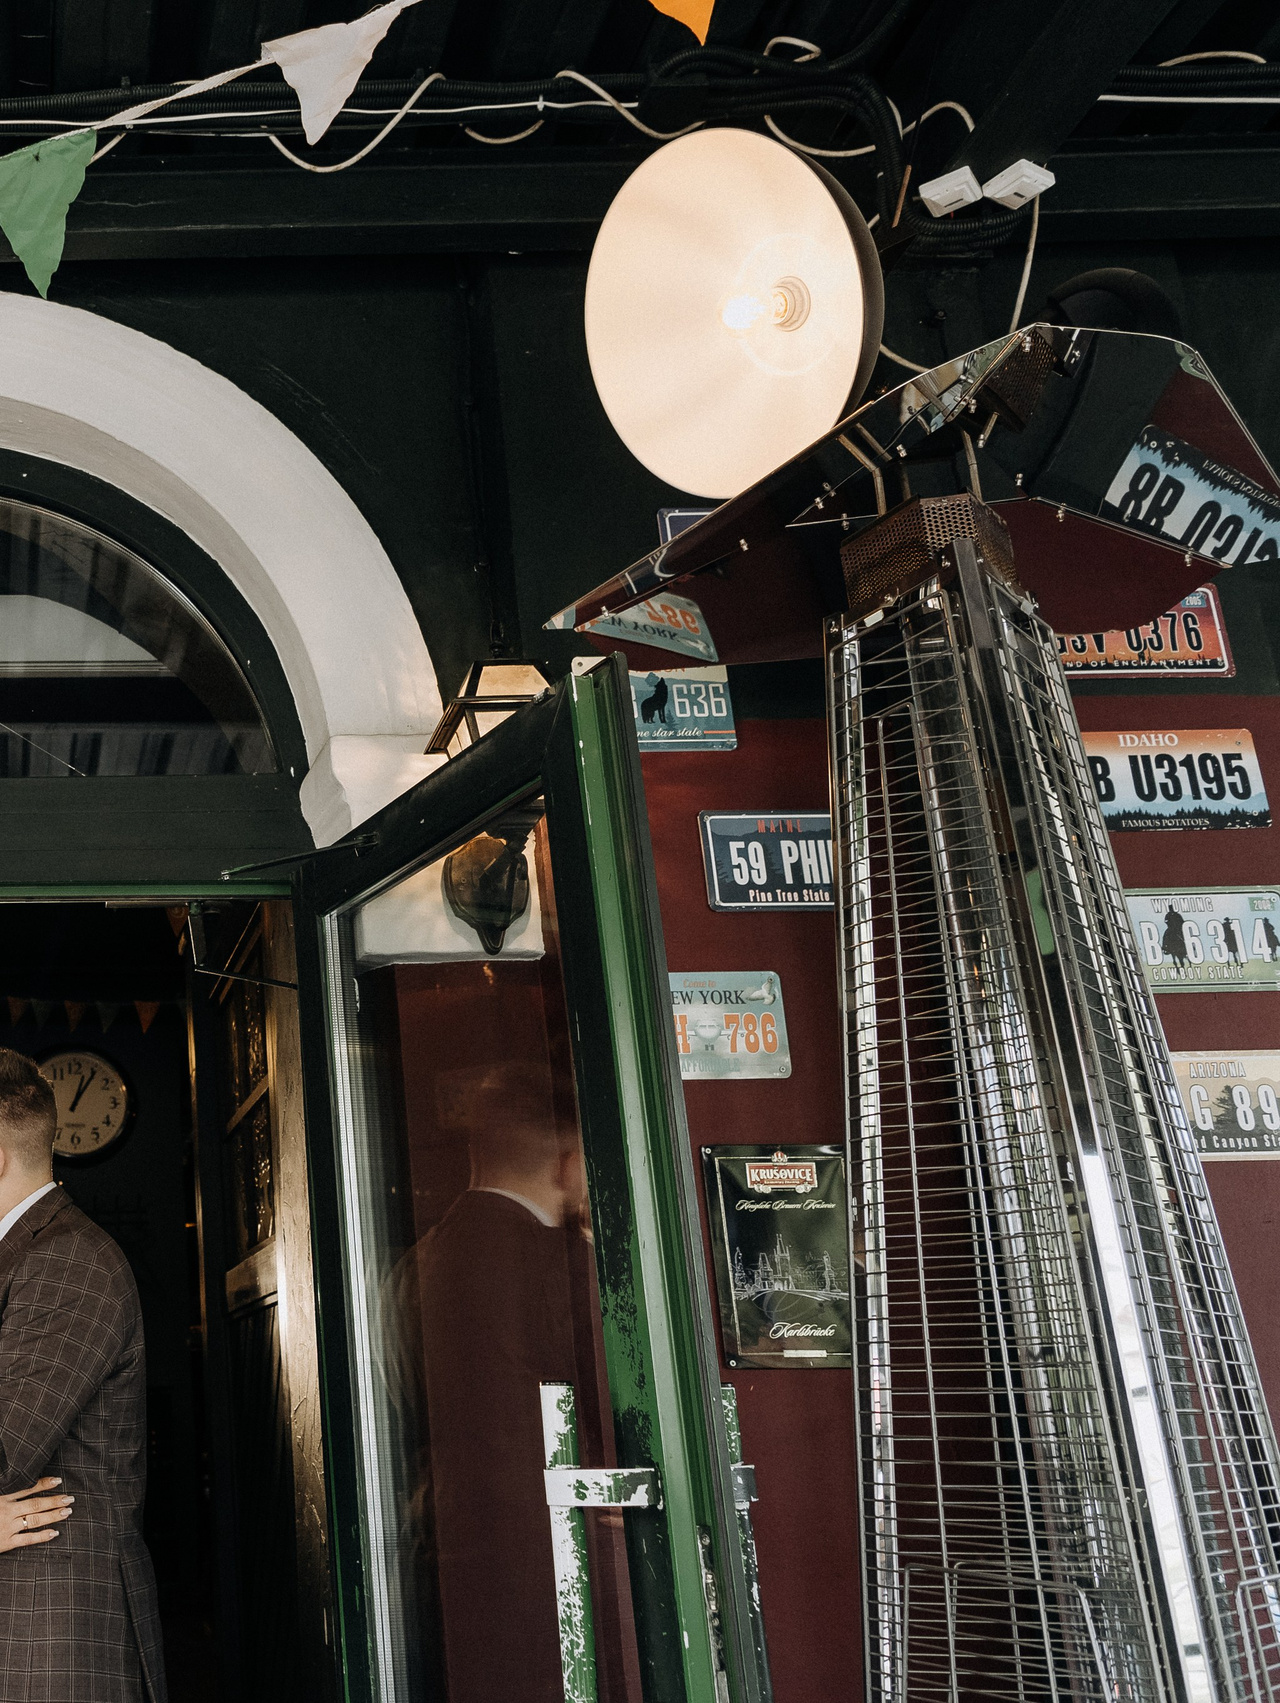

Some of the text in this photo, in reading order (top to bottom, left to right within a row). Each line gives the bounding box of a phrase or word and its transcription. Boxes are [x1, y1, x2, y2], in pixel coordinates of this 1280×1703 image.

[1066, 658, 1211, 668] ND OF ENCHANTMENT
[672, 683, 728, 718] 636
[1117, 733, 1179, 748] IDAHO
[1087, 752, 1252, 802] B U3195
[757, 819, 804, 833] MAINE
[1121, 817, 1210, 828] FAMOUS POTATOES
[728, 841, 767, 886] 59
[748, 888, 830, 902] Pine Tree State
[1150, 897, 1214, 913] WYOMING
[1152, 965, 1244, 981] COWBOY STATE
[671, 990, 747, 1006] EW YORK
[723, 1012, 779, 1054] 786
[68, 1061, 83, 1075] 12
[1189, 1062, 1246, 1078] ARIZONA
[1190, 1084, 1214, 1131] G
[1212, 1135, 1258, 1150] Canyon
[769, 1321, 837, 1339] Karlsbrücke
